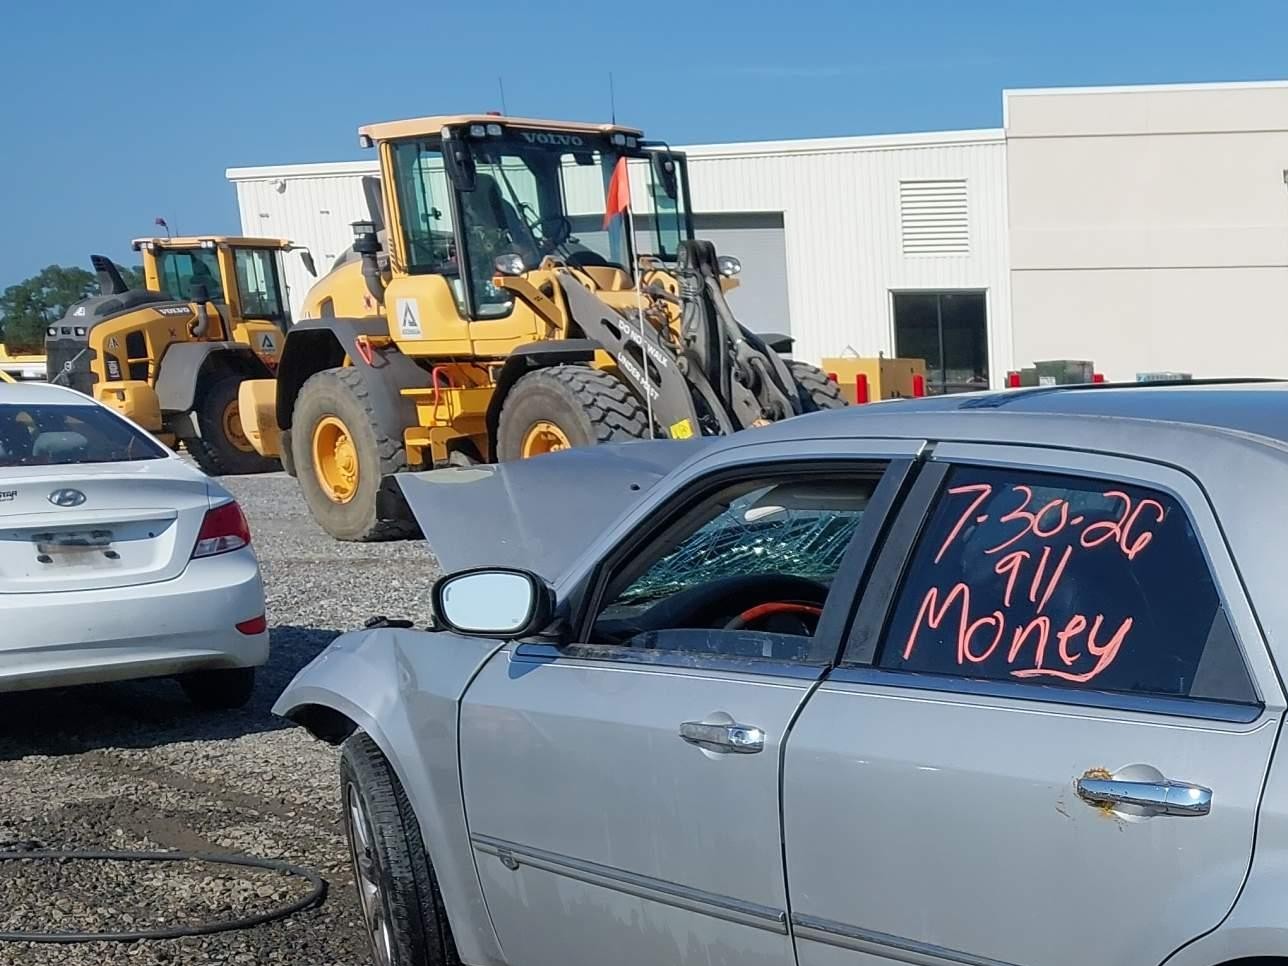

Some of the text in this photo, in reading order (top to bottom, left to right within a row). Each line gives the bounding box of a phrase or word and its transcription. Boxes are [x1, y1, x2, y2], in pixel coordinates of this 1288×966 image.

[521, 132, 584, 146] VOLVO
[618, 319, 631, 334] DO
[646, 343, 669, 368] WALK
[994, 545, 1074, 614] 911
[903, 582, 1134, 682] Money
